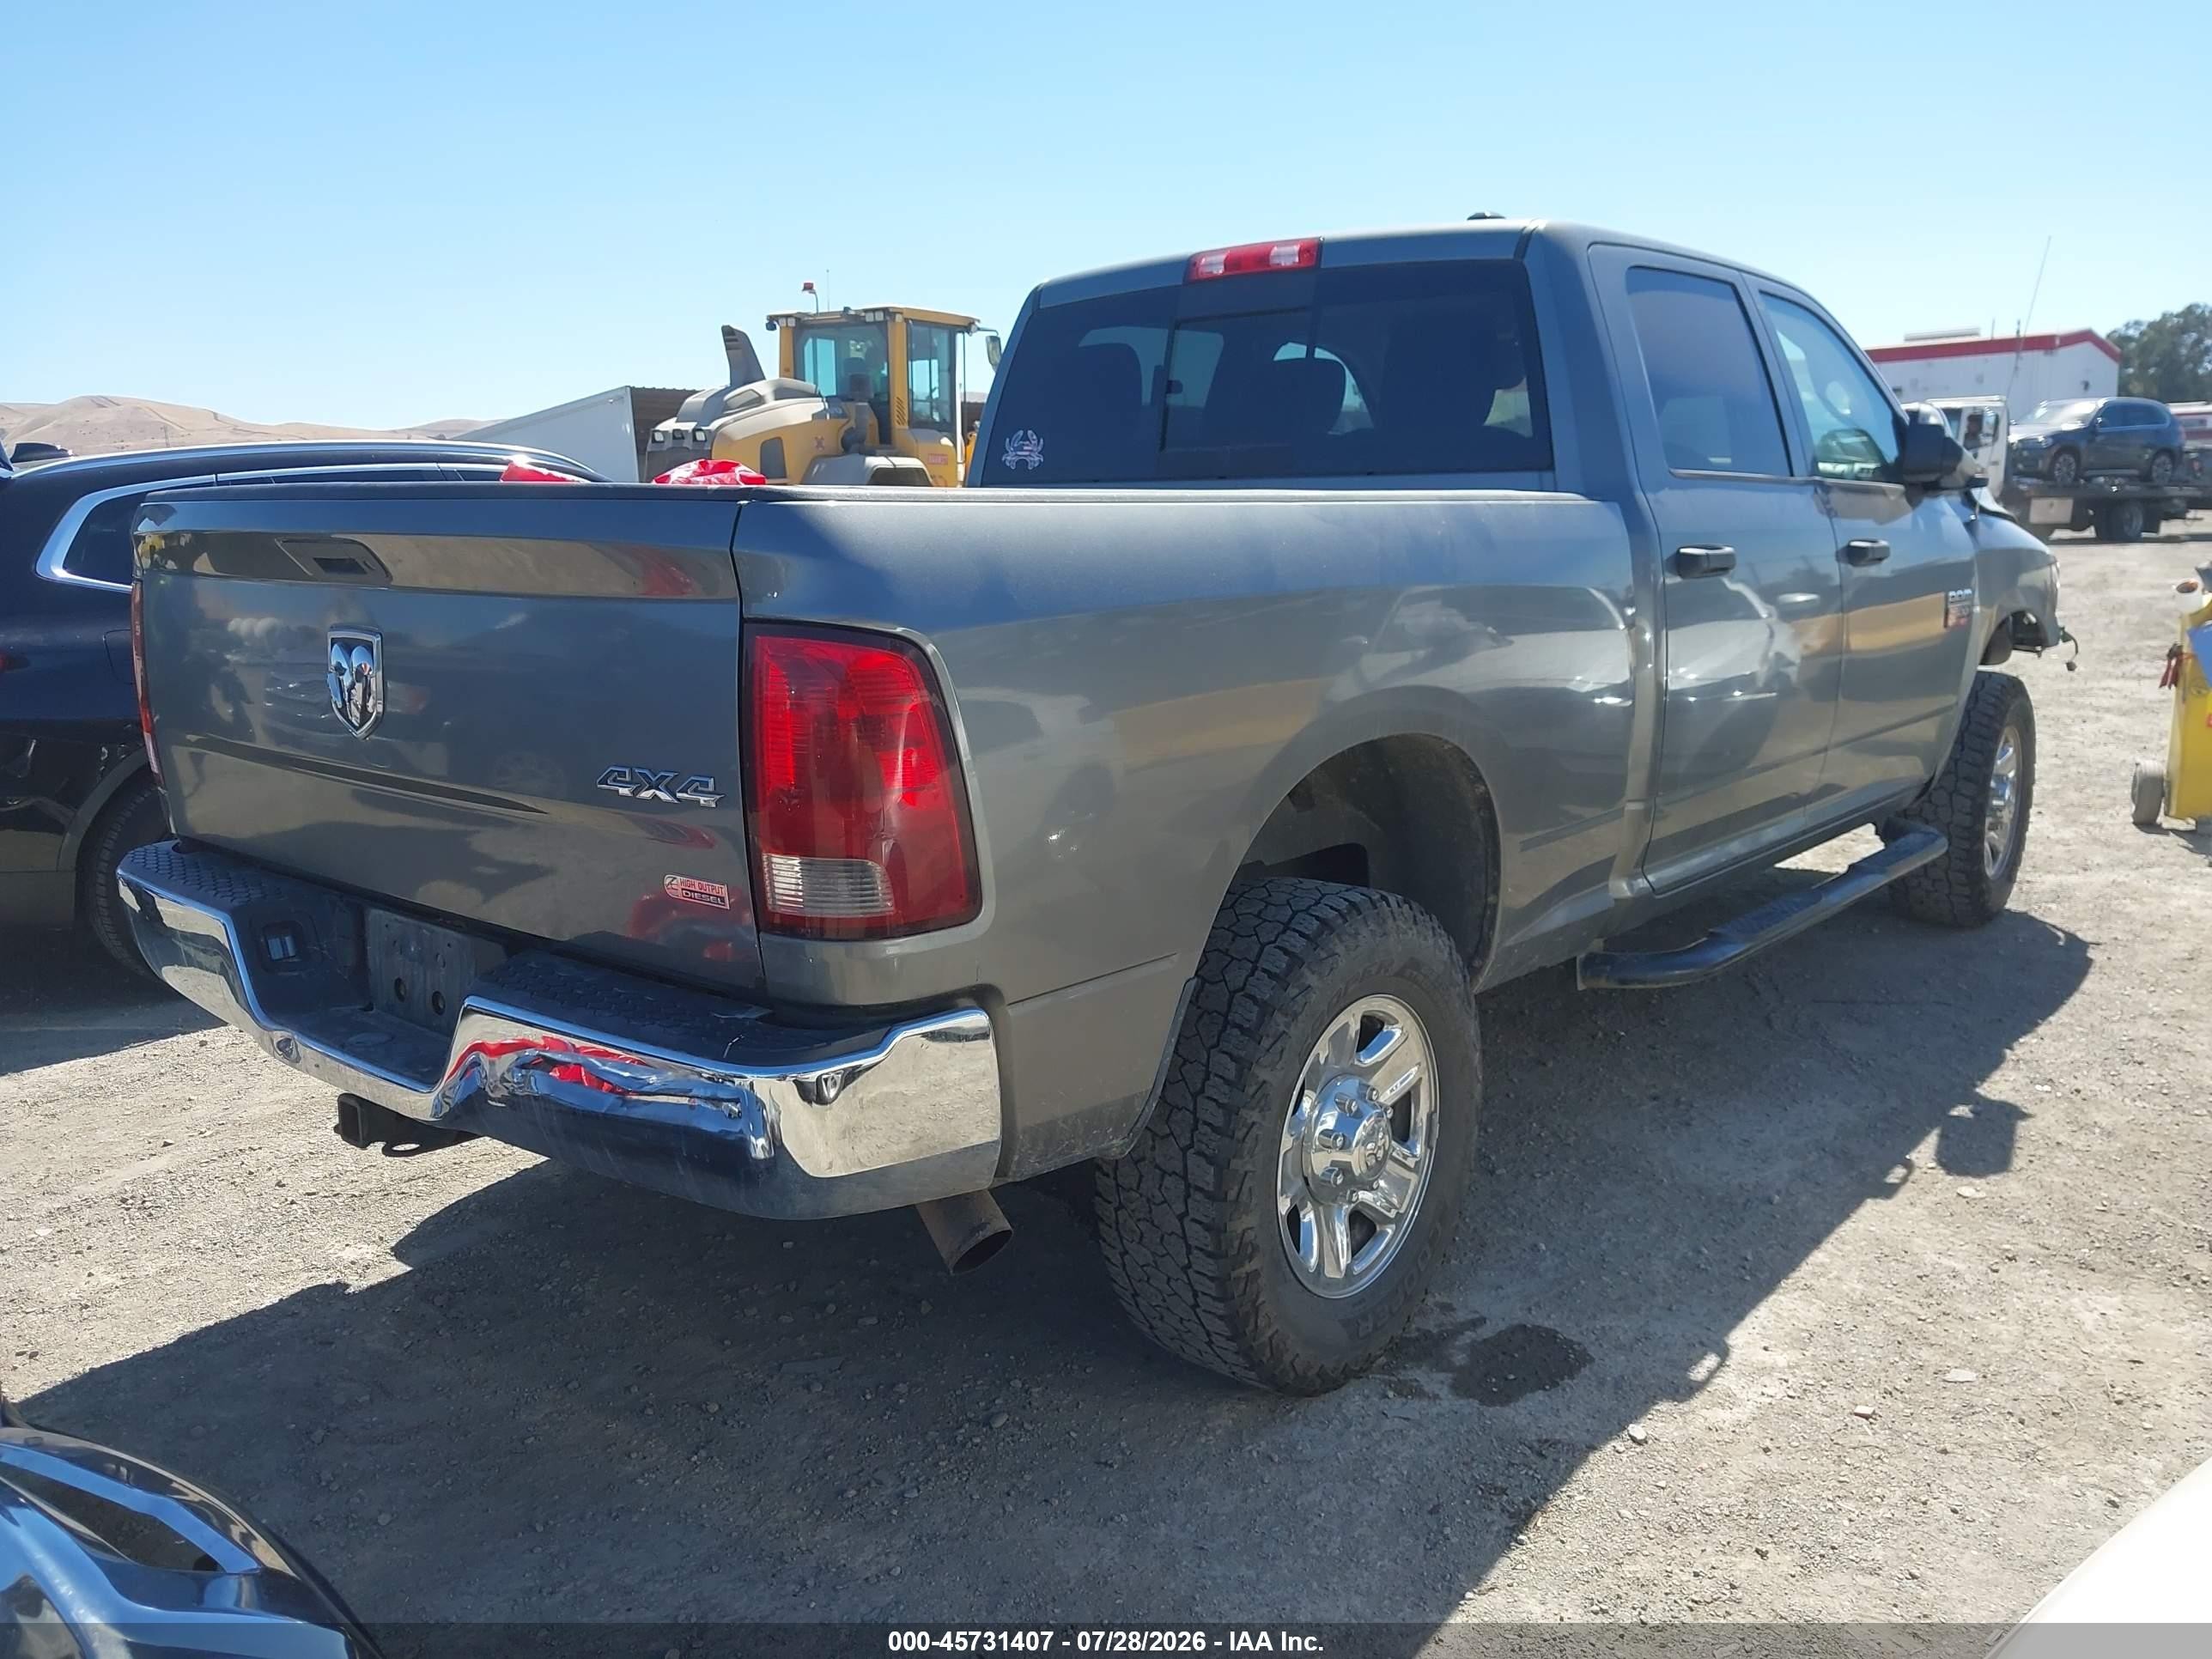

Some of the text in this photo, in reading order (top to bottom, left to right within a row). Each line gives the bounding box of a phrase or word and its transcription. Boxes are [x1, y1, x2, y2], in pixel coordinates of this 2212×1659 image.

[679, 878, 724, 896] HIGH OUTPUT
[682, 890, 725, 905] DIESEL
